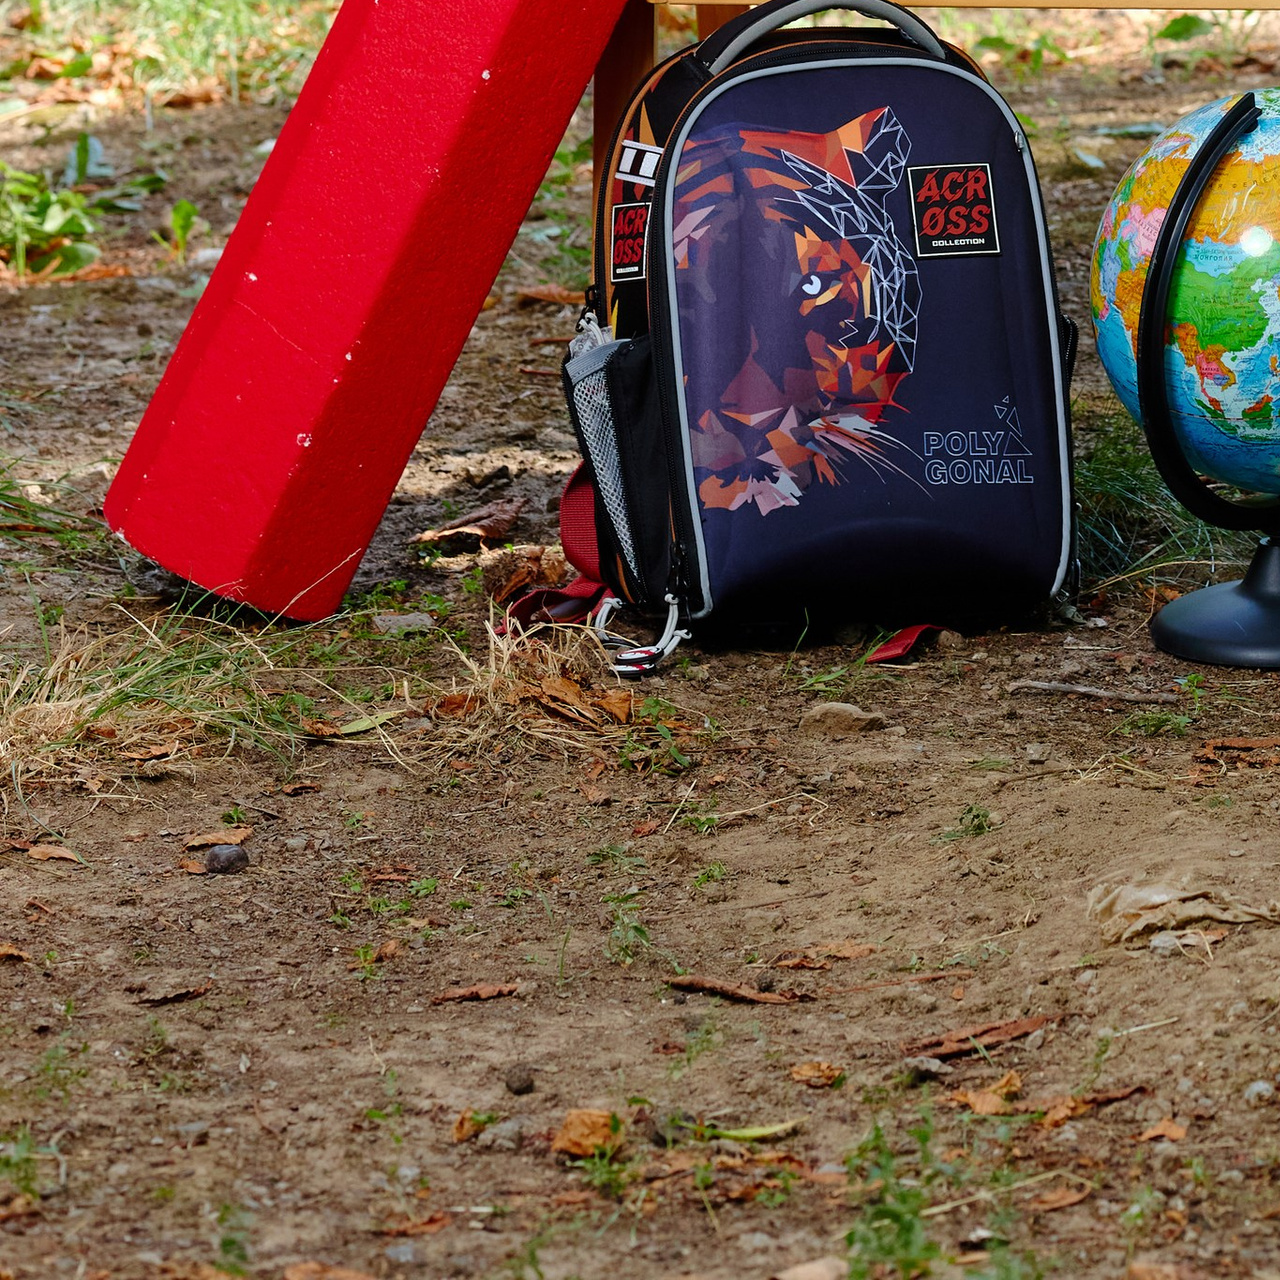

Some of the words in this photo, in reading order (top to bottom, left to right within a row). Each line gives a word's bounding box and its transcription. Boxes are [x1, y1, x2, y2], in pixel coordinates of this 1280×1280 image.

[916, 167, 987, 205] ACR
[613, 206, 647, 237] ACR
[932, 238, 985, 247] COLLECTION
[923, 431, 1004, 456] POLY
[925, 460, 1034, 484] GONAL
